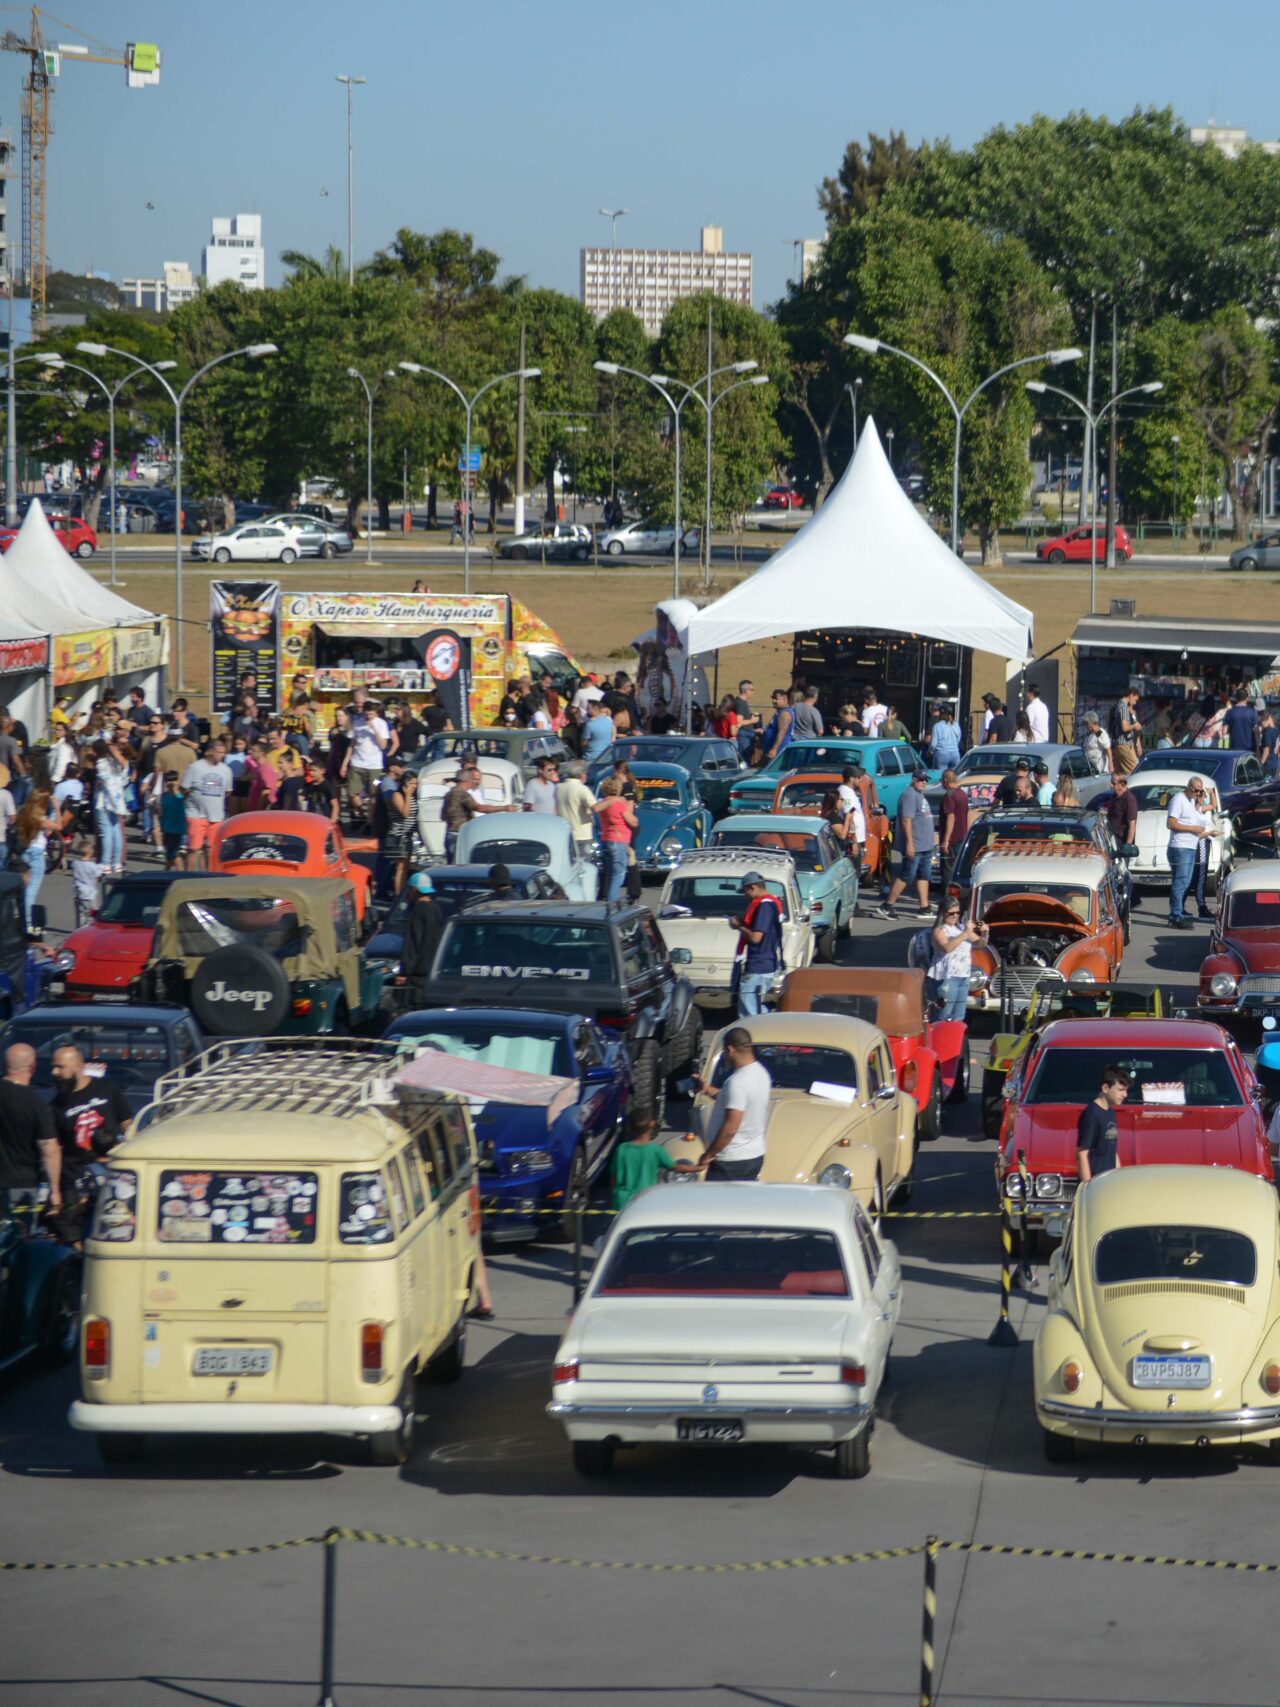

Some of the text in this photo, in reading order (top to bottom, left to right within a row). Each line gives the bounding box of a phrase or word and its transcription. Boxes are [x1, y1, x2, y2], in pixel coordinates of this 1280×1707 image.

[291, 600, 307, 615] O
[309, 600, 369, 620] Xapero
[373, 599, 494, 620] Hamburgueria
[461, 964, 590, 980] ENVEMO
[204, 981, 273, 1011] Jeep
[1142, 1364, 1201, 1378] BVP5J87
